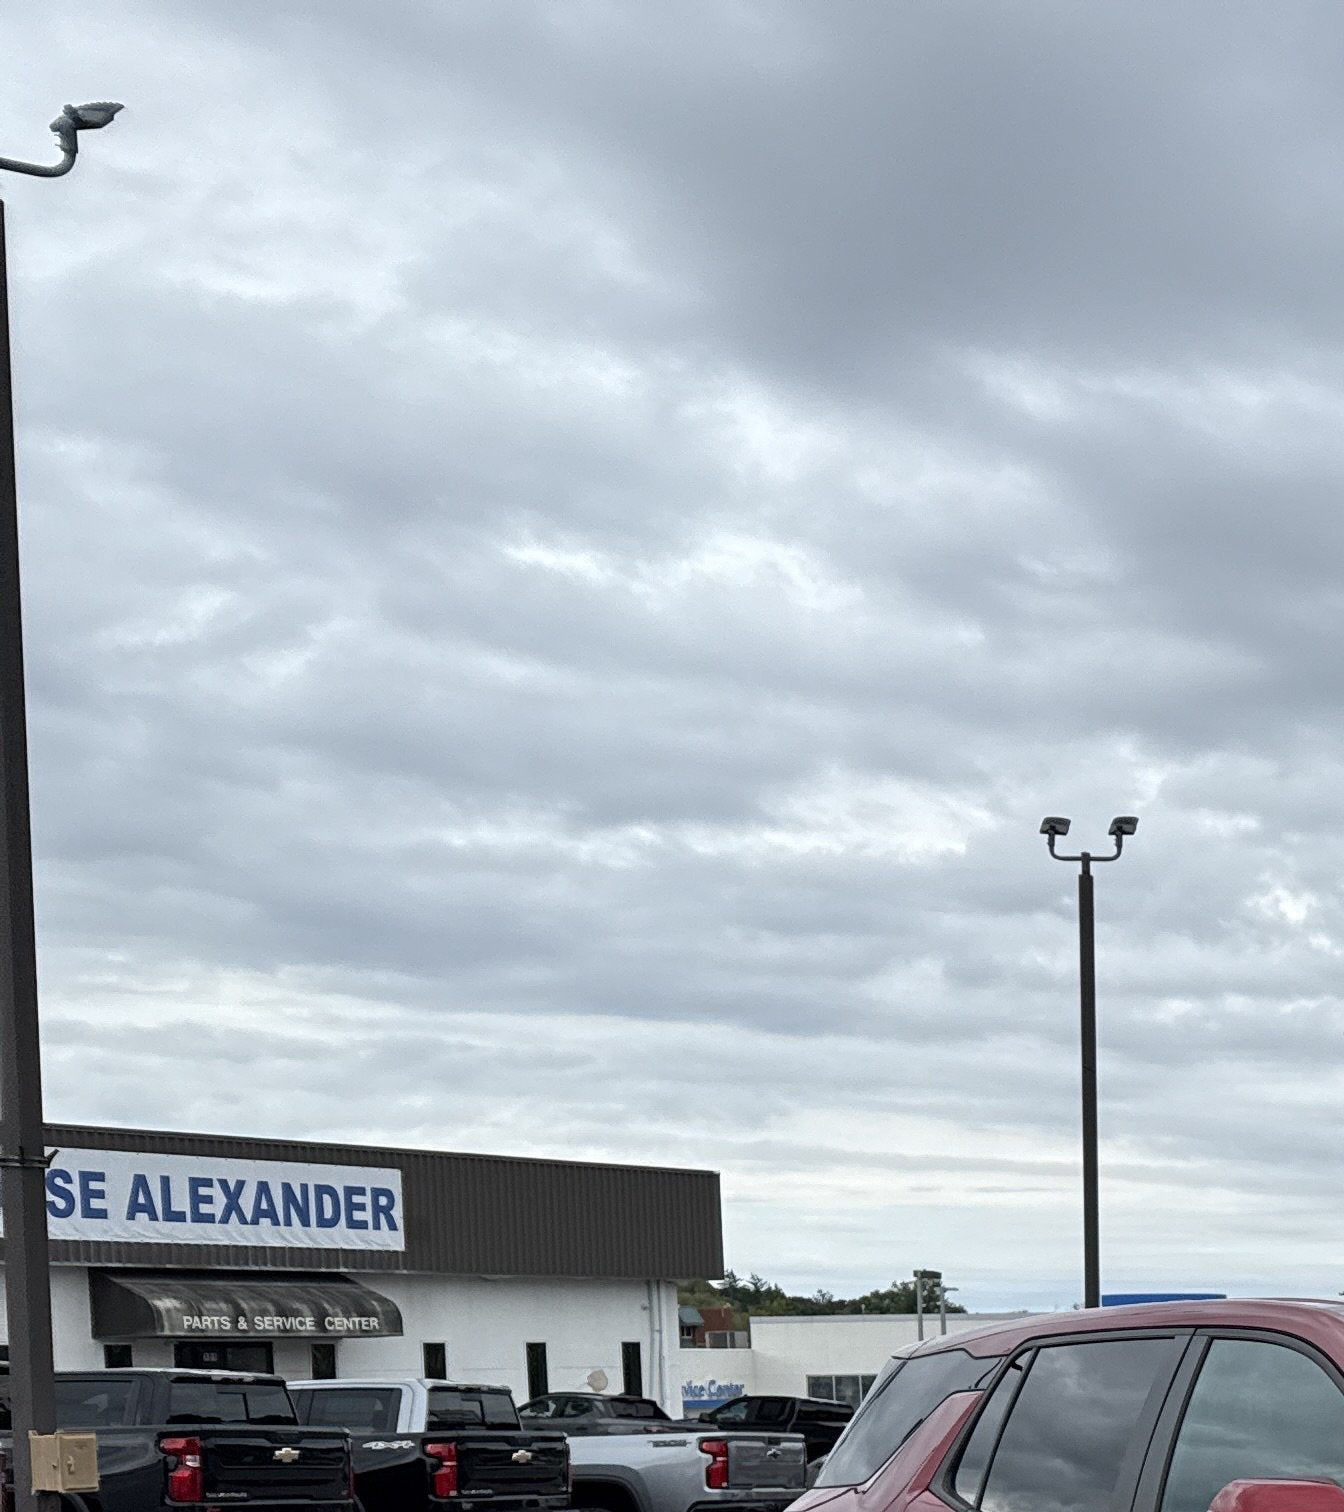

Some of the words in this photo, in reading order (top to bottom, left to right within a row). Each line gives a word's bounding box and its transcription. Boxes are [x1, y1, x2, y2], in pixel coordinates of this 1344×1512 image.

[125, 1173, 399, 1232] ALEXANDER
[183, 1316, 232, 1330] PARTS
[238, 1316, 248, 1330] &
[254, 1316, 316, 1331] SERVICE
[324, 1316, 380, 1331] CENTER
[708, 1379, 745, 1398] Center
